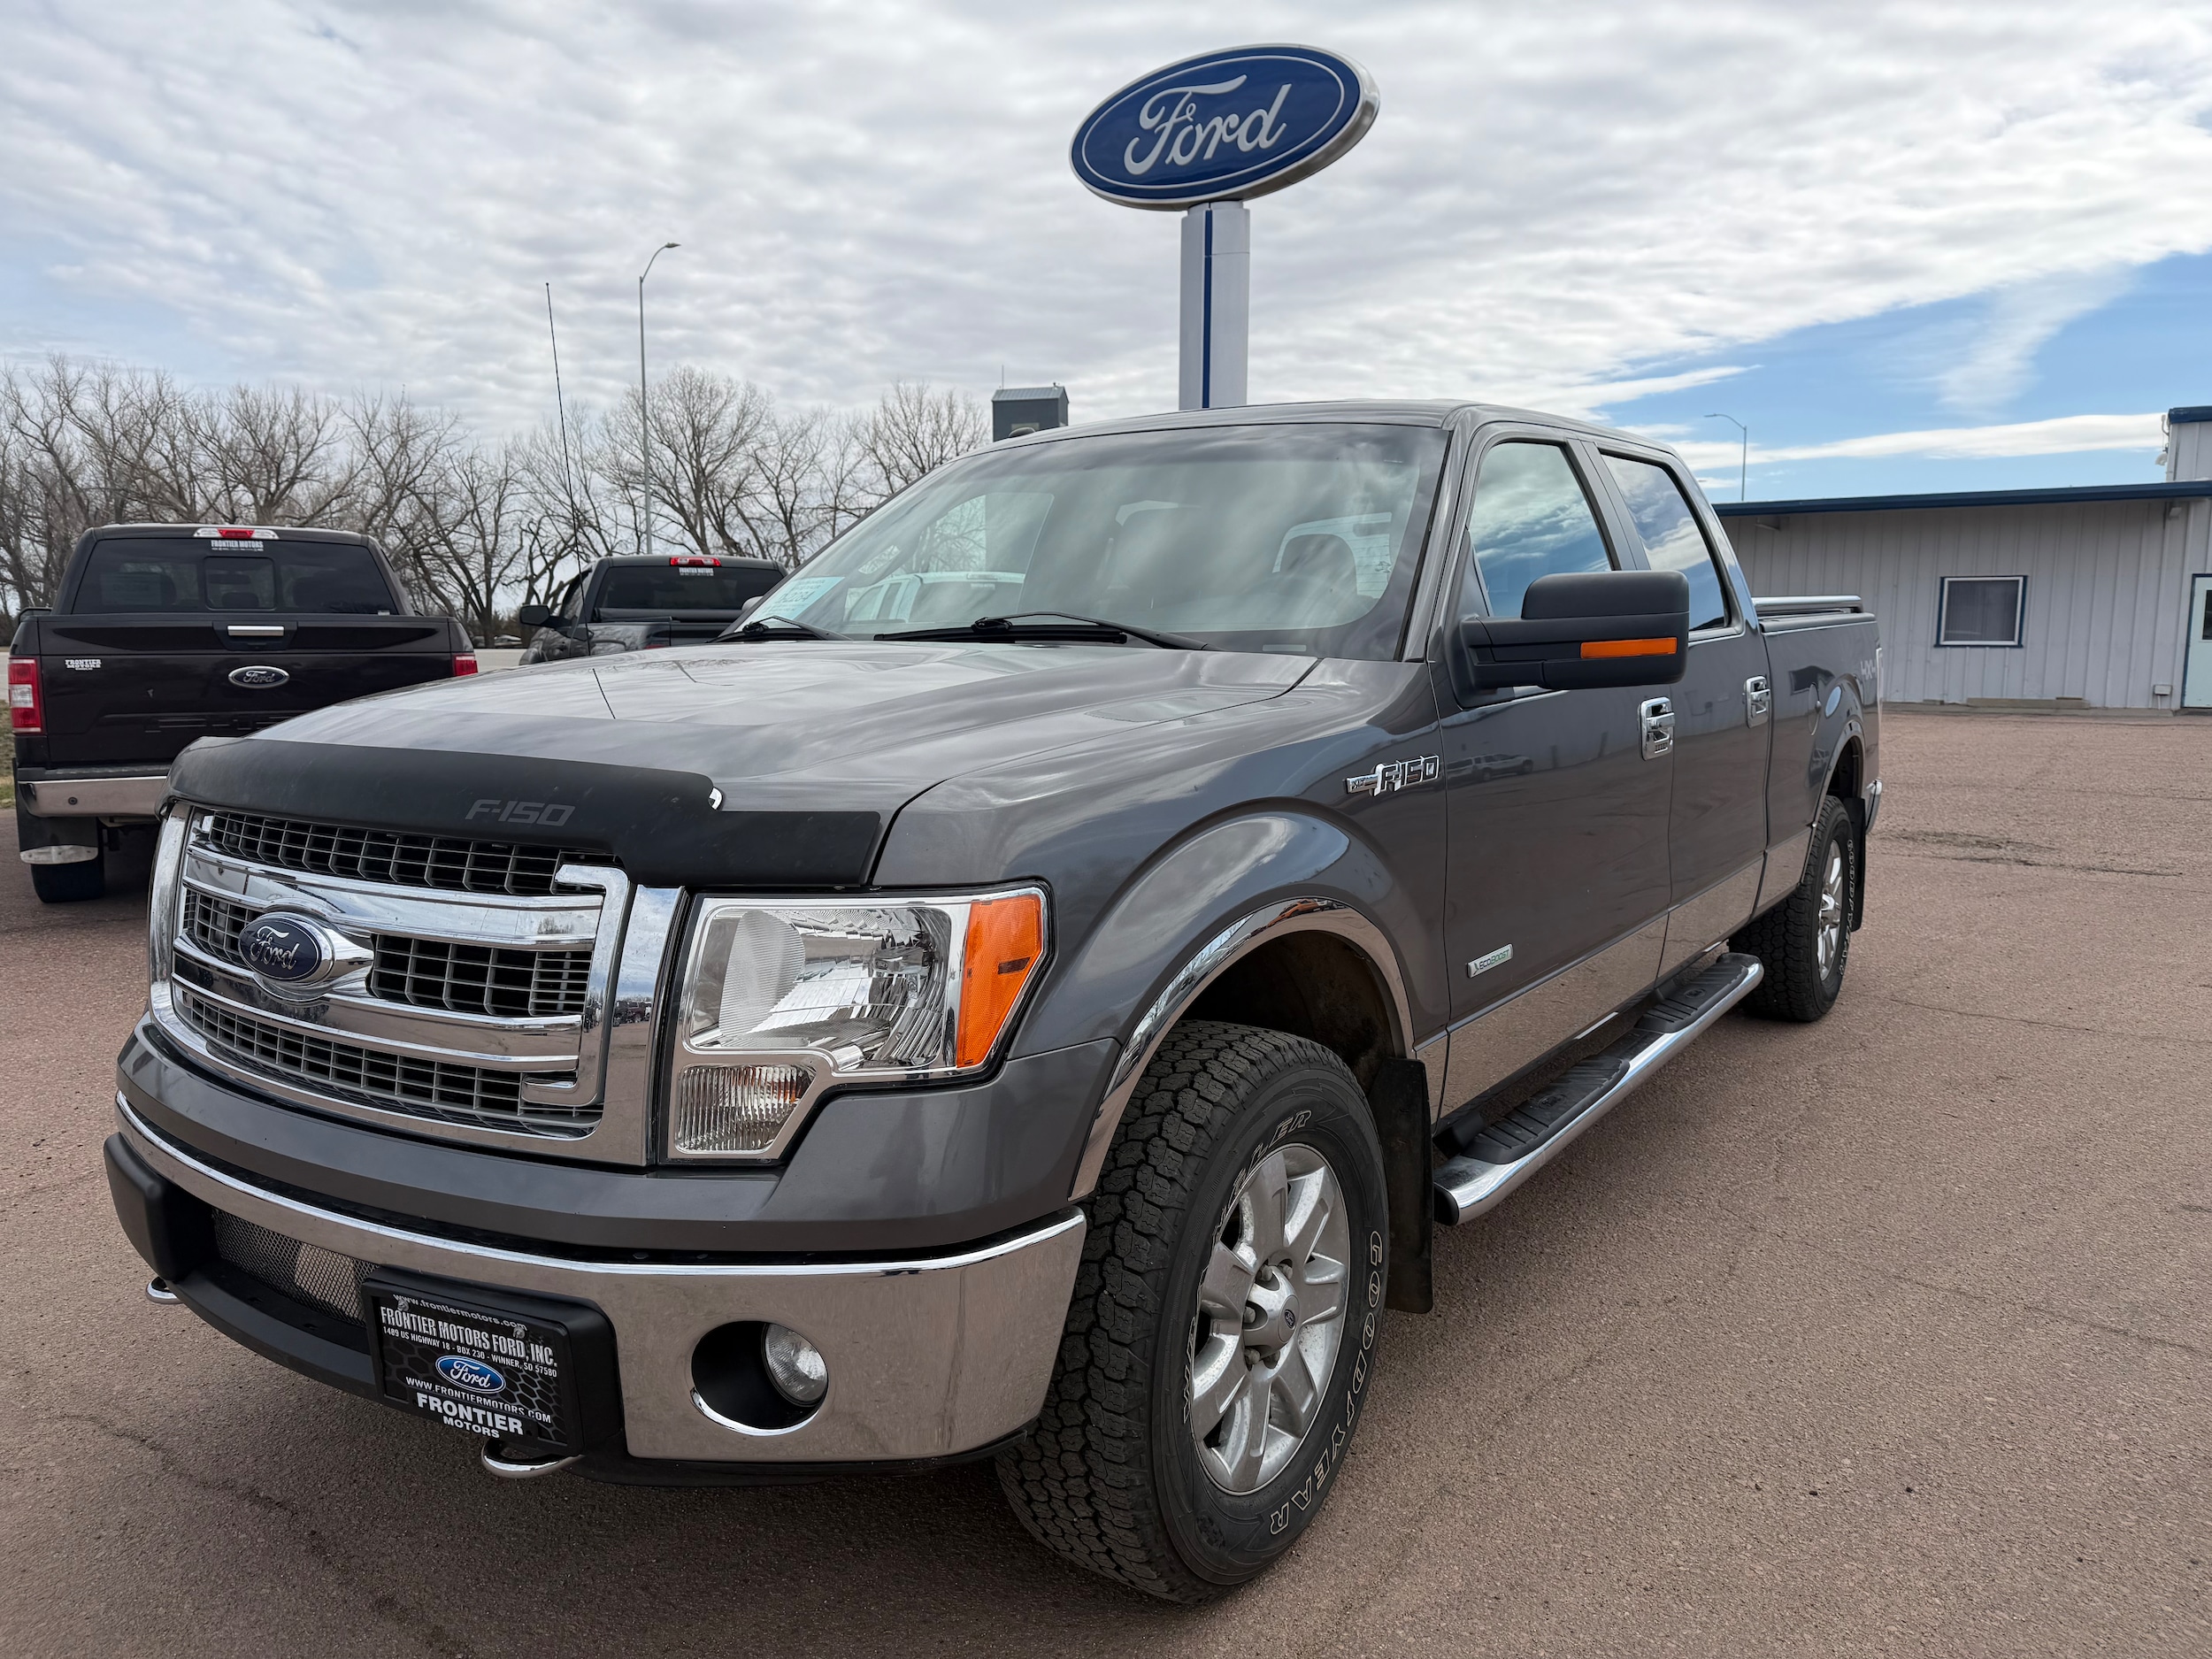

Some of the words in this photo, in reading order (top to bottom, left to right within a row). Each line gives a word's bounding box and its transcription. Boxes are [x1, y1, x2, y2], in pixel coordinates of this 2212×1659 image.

[1124, 74, 1292, 174] Ford
[243, 670, 275, 682] Ford
[465, 799, 575, 826] F-150
[250, 926, 300, 971] Ford
[380, 1306, 437, 1336] FRONTIER
[438, 1320, 490, 1350] MOTORS
[491, 1333, 529, 1362] FORD,
[530, 1342, 558, 1368] INC.
[400, 1330, 410, 1340] US
[411, 1333, 441, 1348] HIGHWAY
[457, 1345, 471, 1356] BOX
[472, 1348, 486, 1360] 230
[523, 1362, 534, 1371] SD
[534, 1364, 557, 1378] 57580
[449, 1360, 491, 1388] Ford
[1270, 1231, 1383, 1536] GOODYEAR
[405, 1376, 552, 1424] WWW.FRONTIERMOTORS.COM
[416, 1392, 524, 1436] FRONTIER
[442, 1416, 500, 1439] MOTORS
